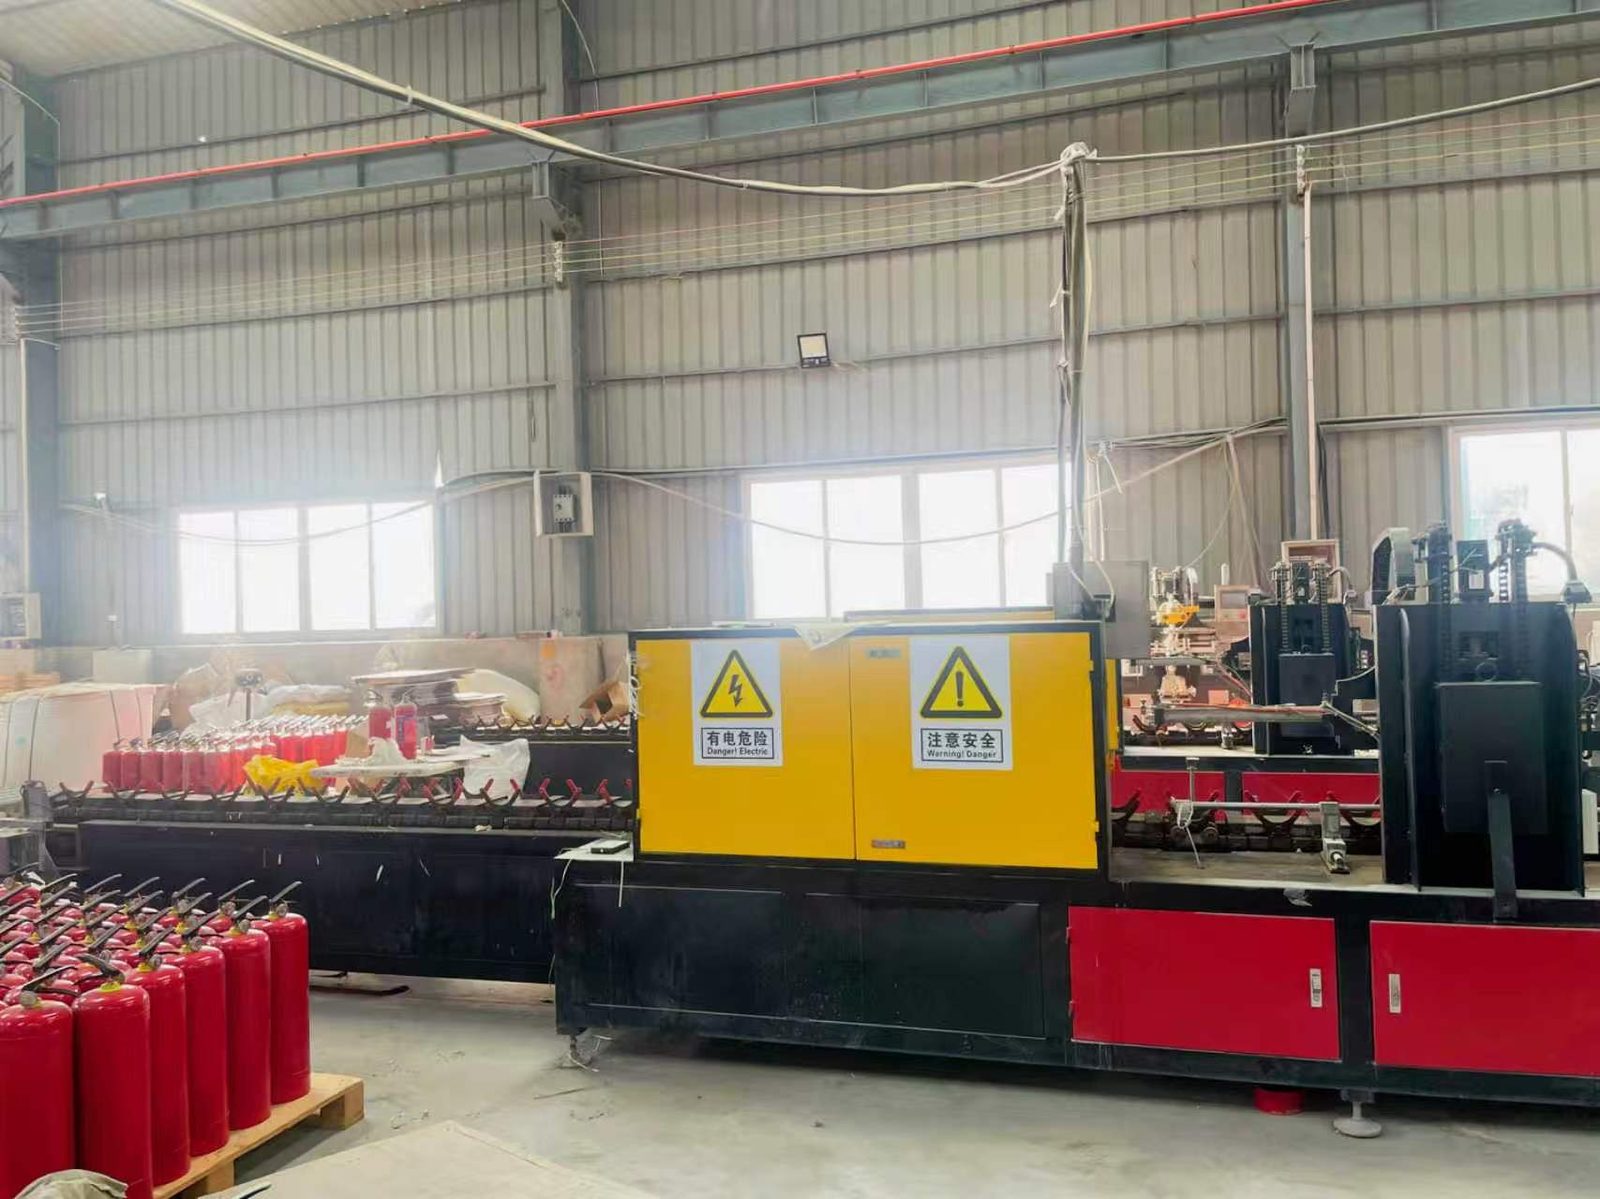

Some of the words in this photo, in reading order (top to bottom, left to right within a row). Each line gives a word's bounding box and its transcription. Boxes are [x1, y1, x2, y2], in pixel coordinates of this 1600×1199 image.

[706, 730, 768, 746] 有电危险
[927, 732, 996, 748] 注意安全
[707, 747, 737, 756] Danger!
[739, 747, 768, 755] Electric
[927, 749, 964, 758] Warning!
[966, 750, 997, 759] Danger
